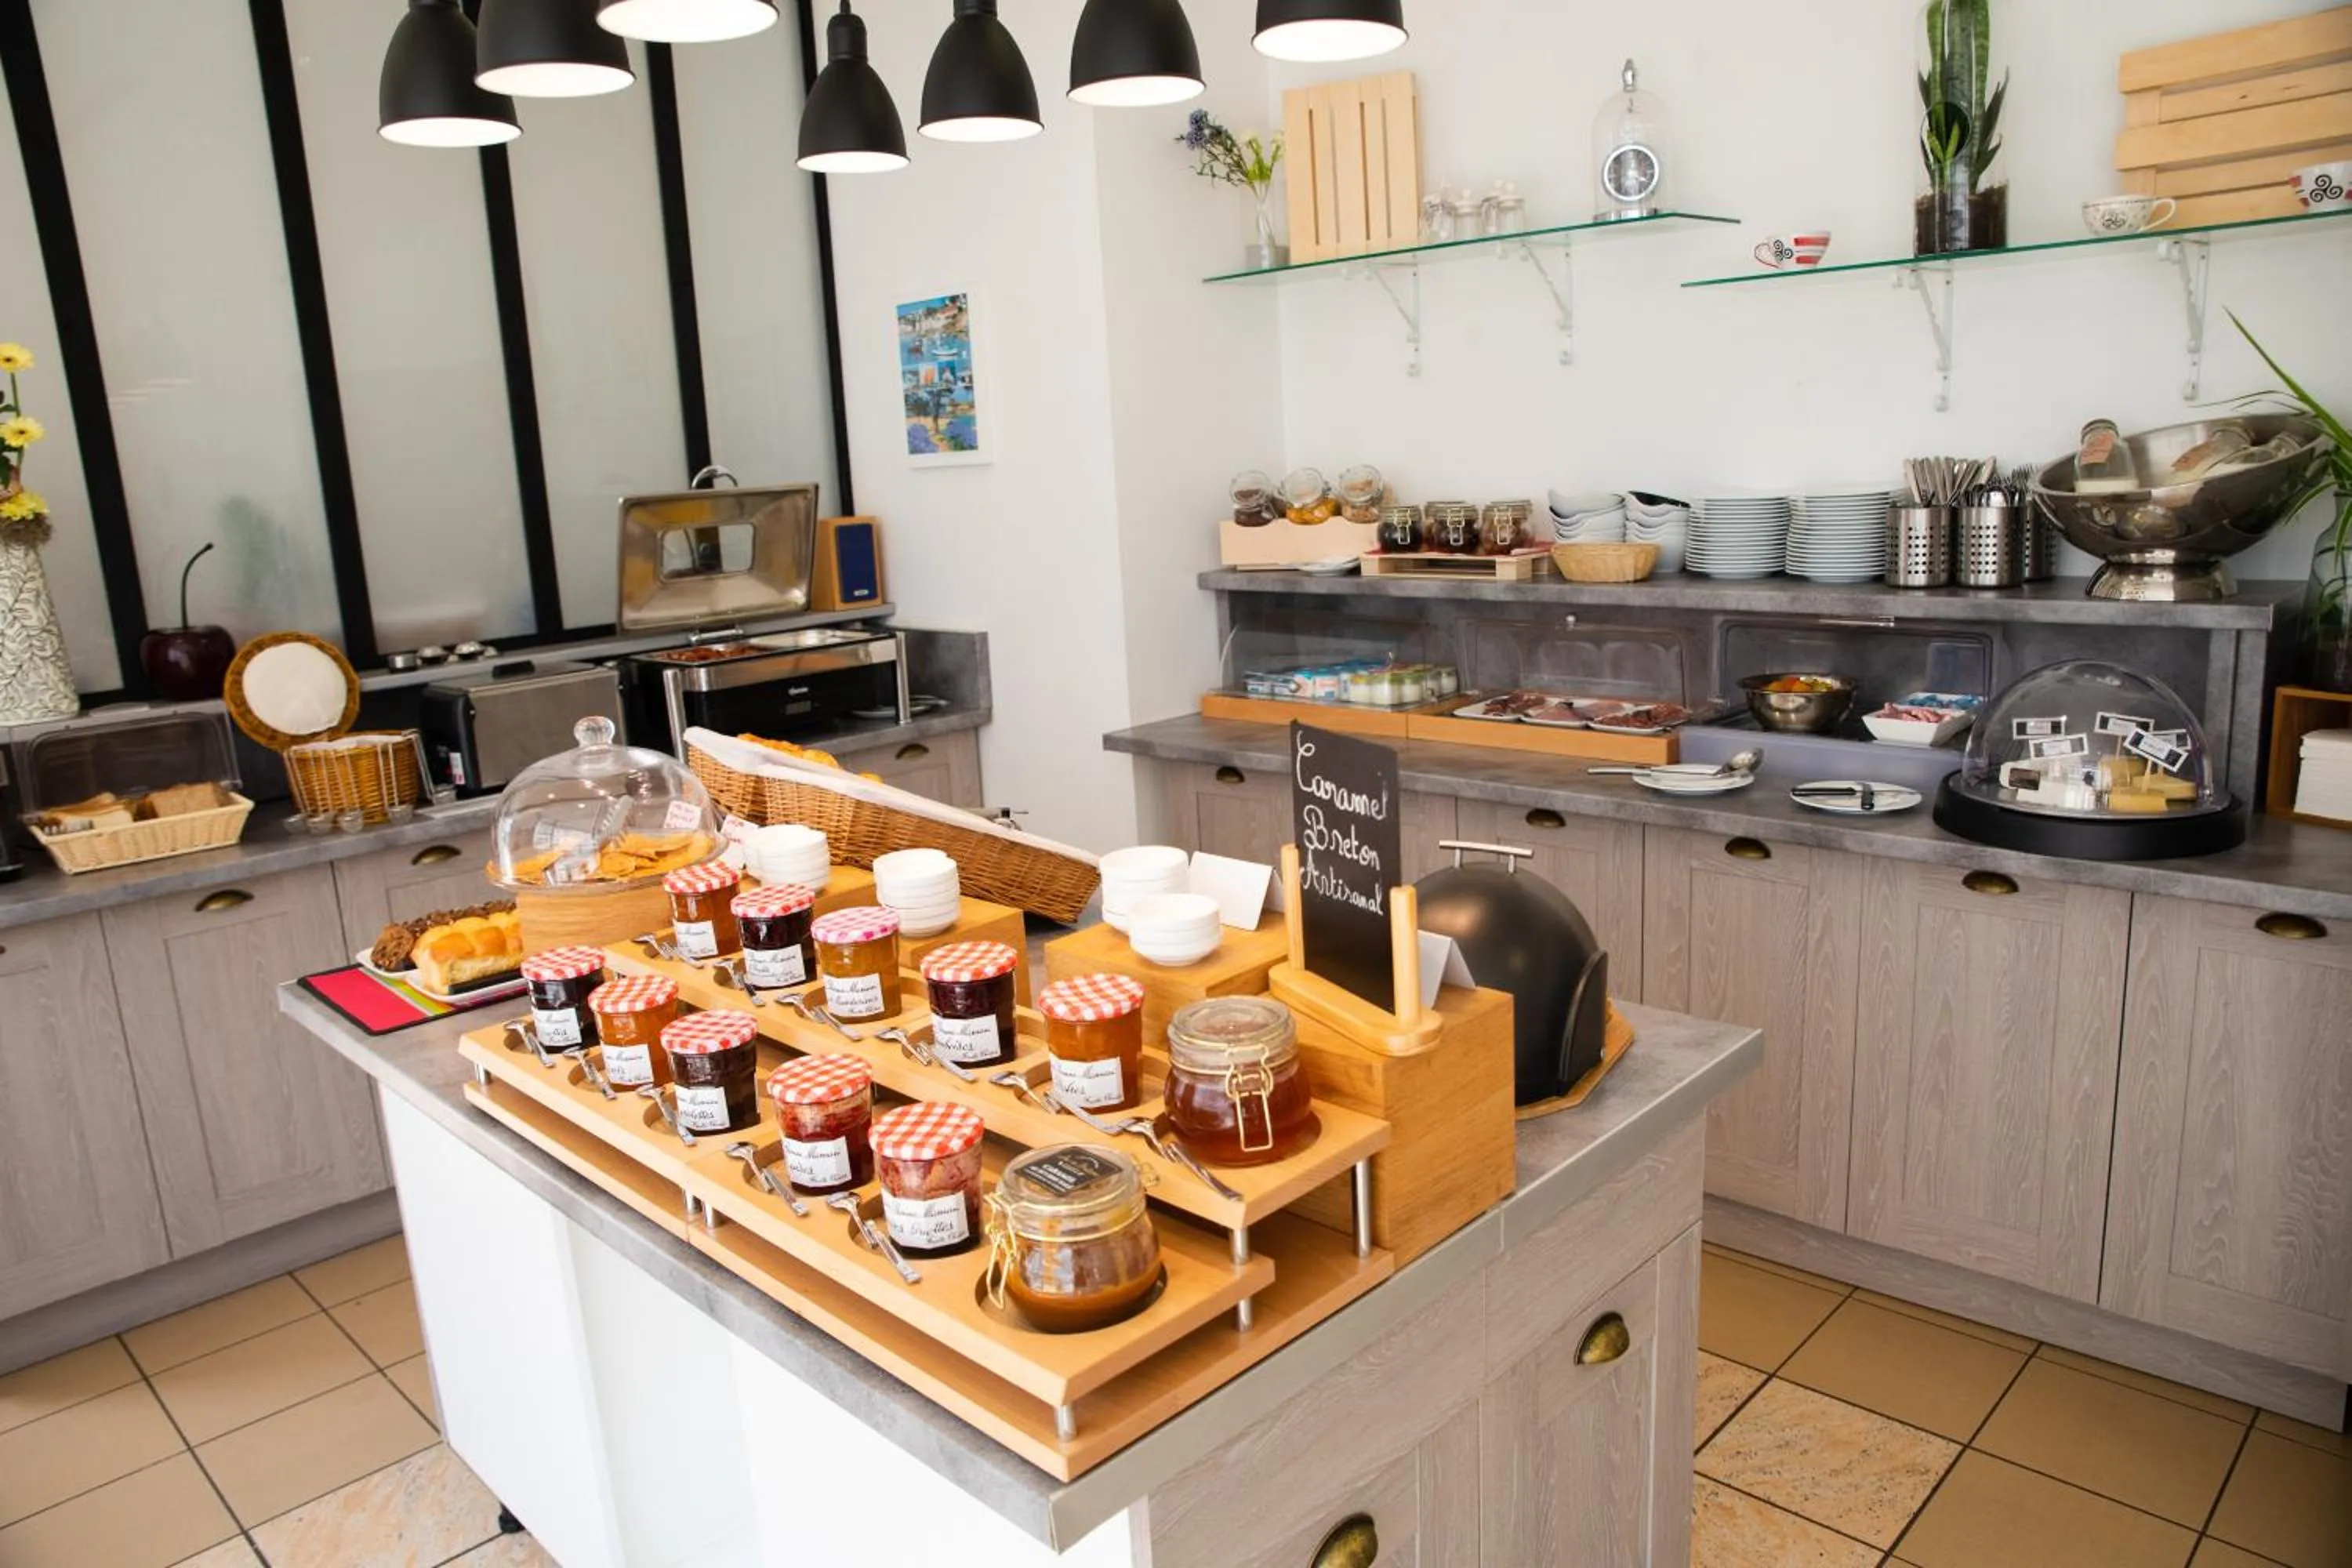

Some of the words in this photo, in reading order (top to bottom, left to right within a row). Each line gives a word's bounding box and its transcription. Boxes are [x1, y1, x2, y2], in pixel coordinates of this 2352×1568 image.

[1296, 730, 1388, 821] Caramel
[1303, 804, 1381, 871] Breton
[1299, 848, 1384, 916] Artisanal
